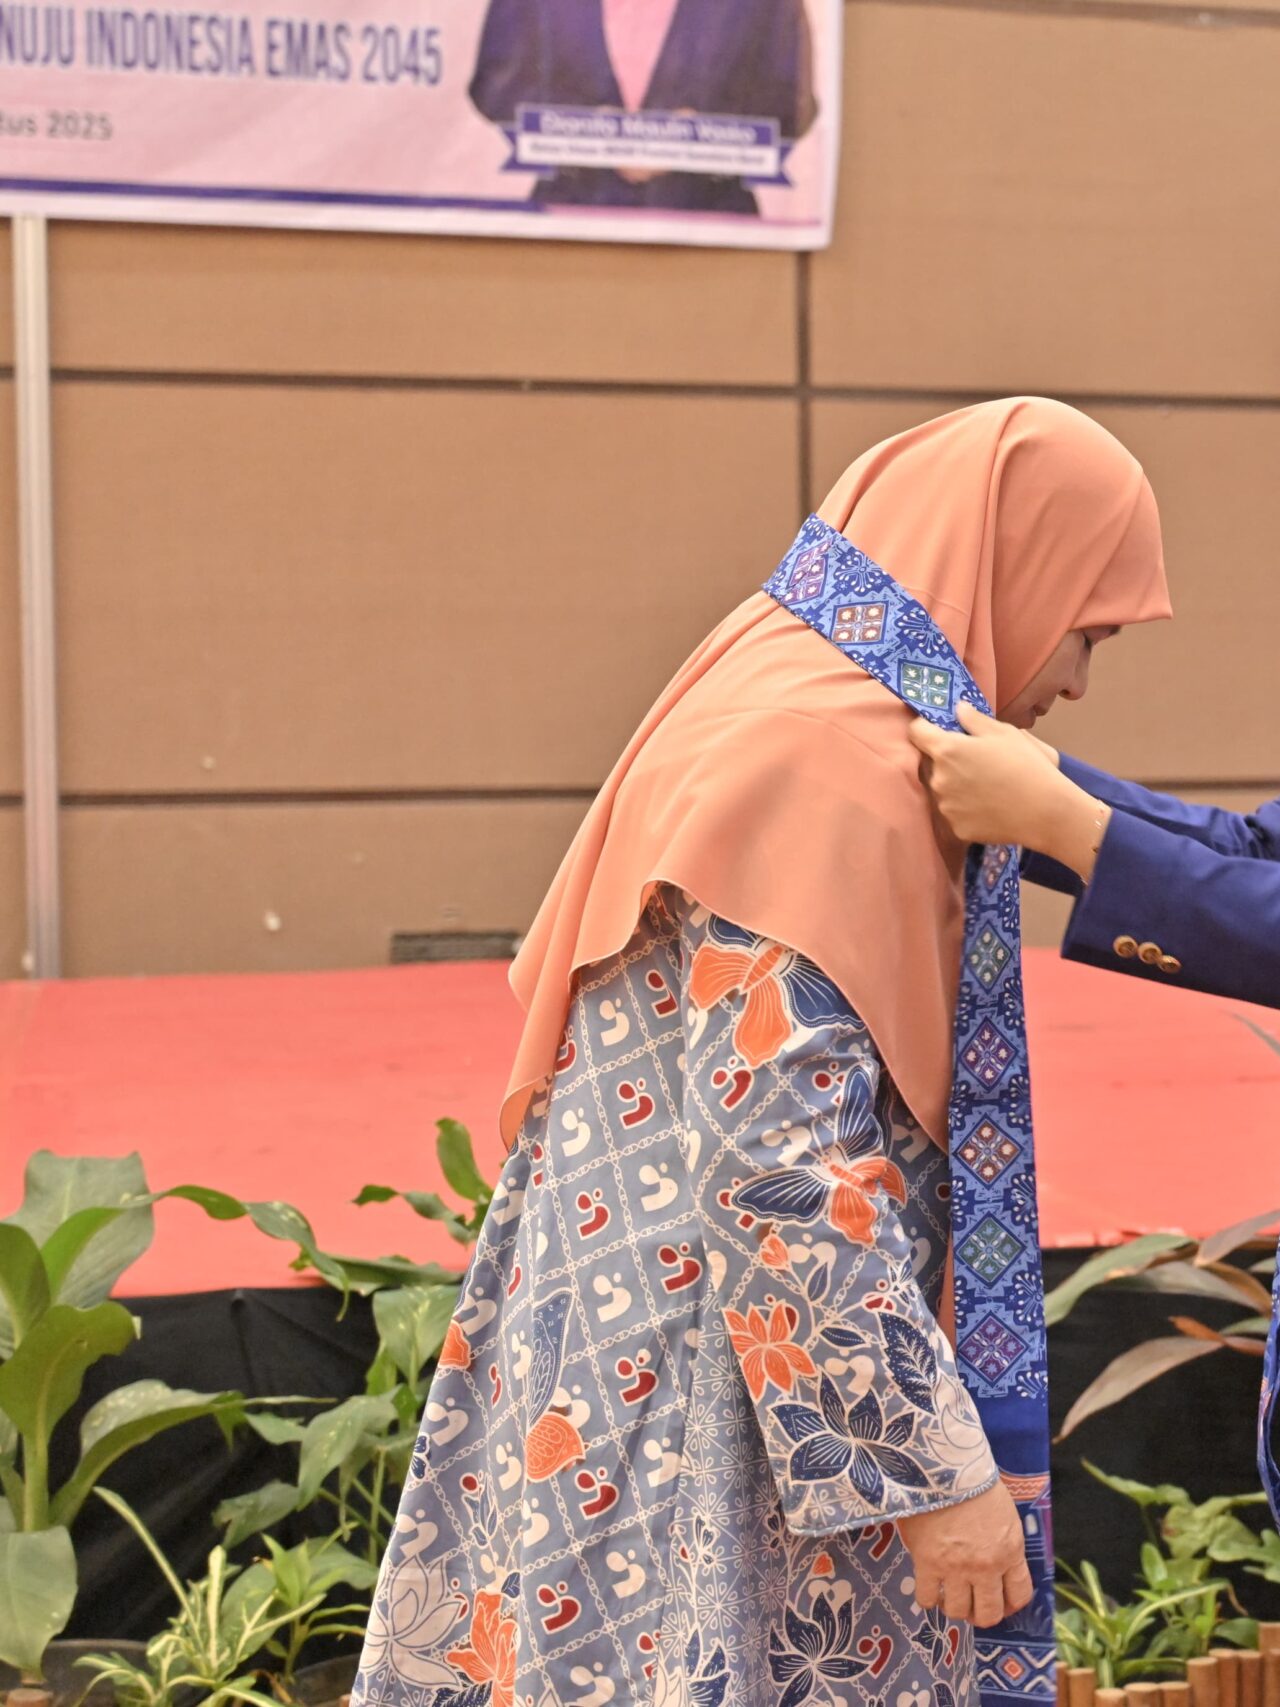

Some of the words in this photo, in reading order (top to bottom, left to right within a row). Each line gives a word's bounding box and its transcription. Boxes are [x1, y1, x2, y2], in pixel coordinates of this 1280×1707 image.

[86, 10, 257, 76] INDONESIA
[265, 20, 352, 82] EMAS
[361, 26, 443, 86] 2045
[47, 111, 114, 141] 2025
